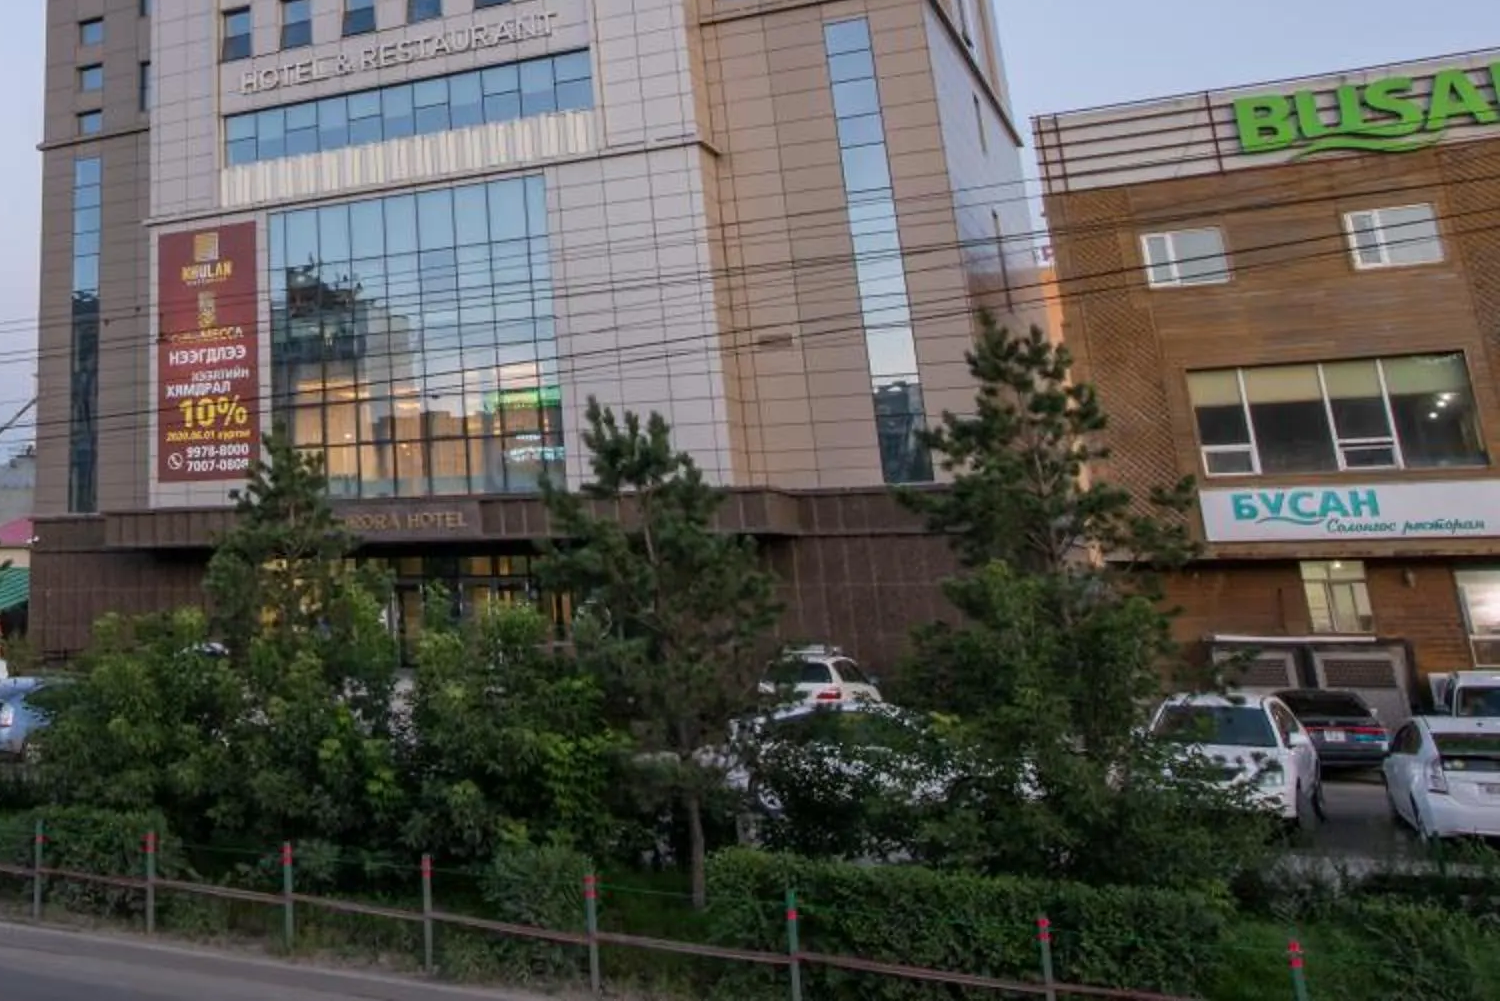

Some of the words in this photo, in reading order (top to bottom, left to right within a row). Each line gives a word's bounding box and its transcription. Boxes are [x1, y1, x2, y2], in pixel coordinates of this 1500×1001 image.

[240, 56, 332, 95] HOTEL
[336, 52, 354, 76] &
[359, 13, 558, 72] RESTAURANT
[1234, 62, 1500, 153] BUSA
[169, 344, 247, 366] НЭЭГДЛЭЭ
[166, 380, 231, 398] ХЯМДРАЛ
[179, 394, 248, 428] 10%
[1230, 488, 1380, 520] БУСАН
[407, 511, 468, 530] HOTEL
[1326, 517, 1397, 534] Солонгос
